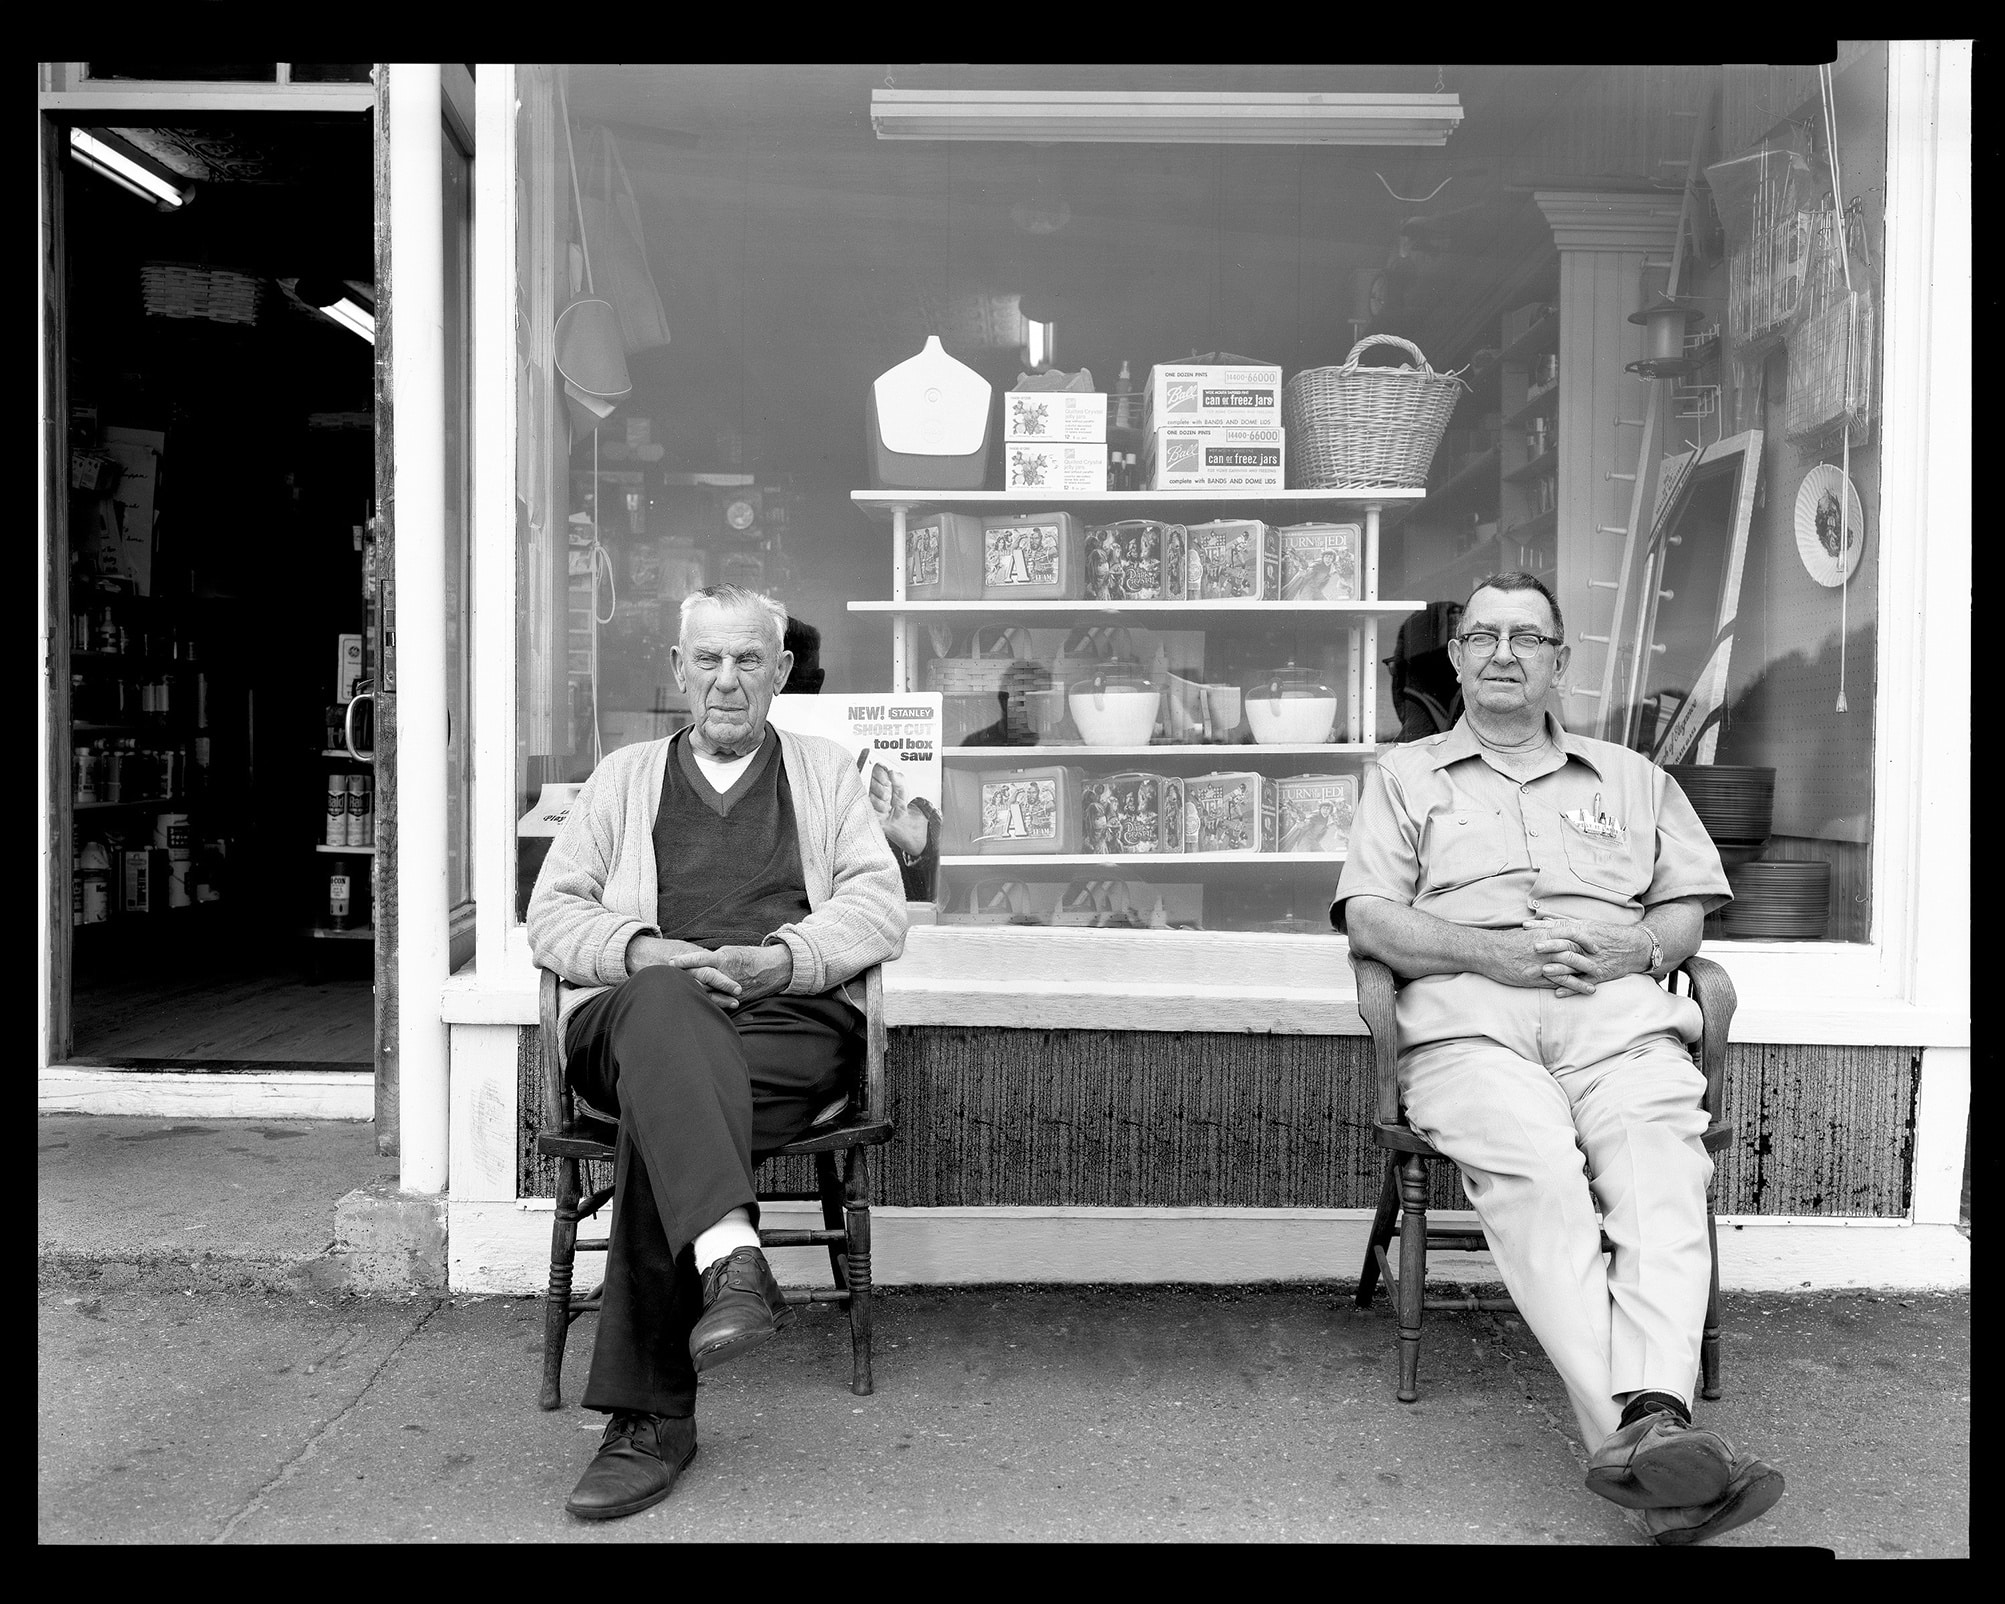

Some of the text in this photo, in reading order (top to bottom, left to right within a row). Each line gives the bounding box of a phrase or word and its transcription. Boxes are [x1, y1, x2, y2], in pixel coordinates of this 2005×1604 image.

[1167, 384, 1198, 405] Ball
[1204, 396, 1220, 406] can
[1230, 394, 1253, 406] freez
[1254, 394, 1273, 407] jars
[1228, 430, 1278, 440] 14400-66000
[1167, 443, 1199, 463] Ball
[1208, 455, 1224, 464] can
[1234, 453, 1258, 464] freez
[1260, 453, 1278, 466] jars
[1324, 535, 1347, 550] JEDI
[1004, 549, 1031, 584] A
[848, 706, 931, 720] NEW! STANLEY
[852, 723, 935, 736] SHORT CUT
[874, 738, 933, 750] tool box
[900, 752, 933, 761] saw
[1322, 786, 1344, 802] JEDI
[1002, 803, 1028, 838] A
